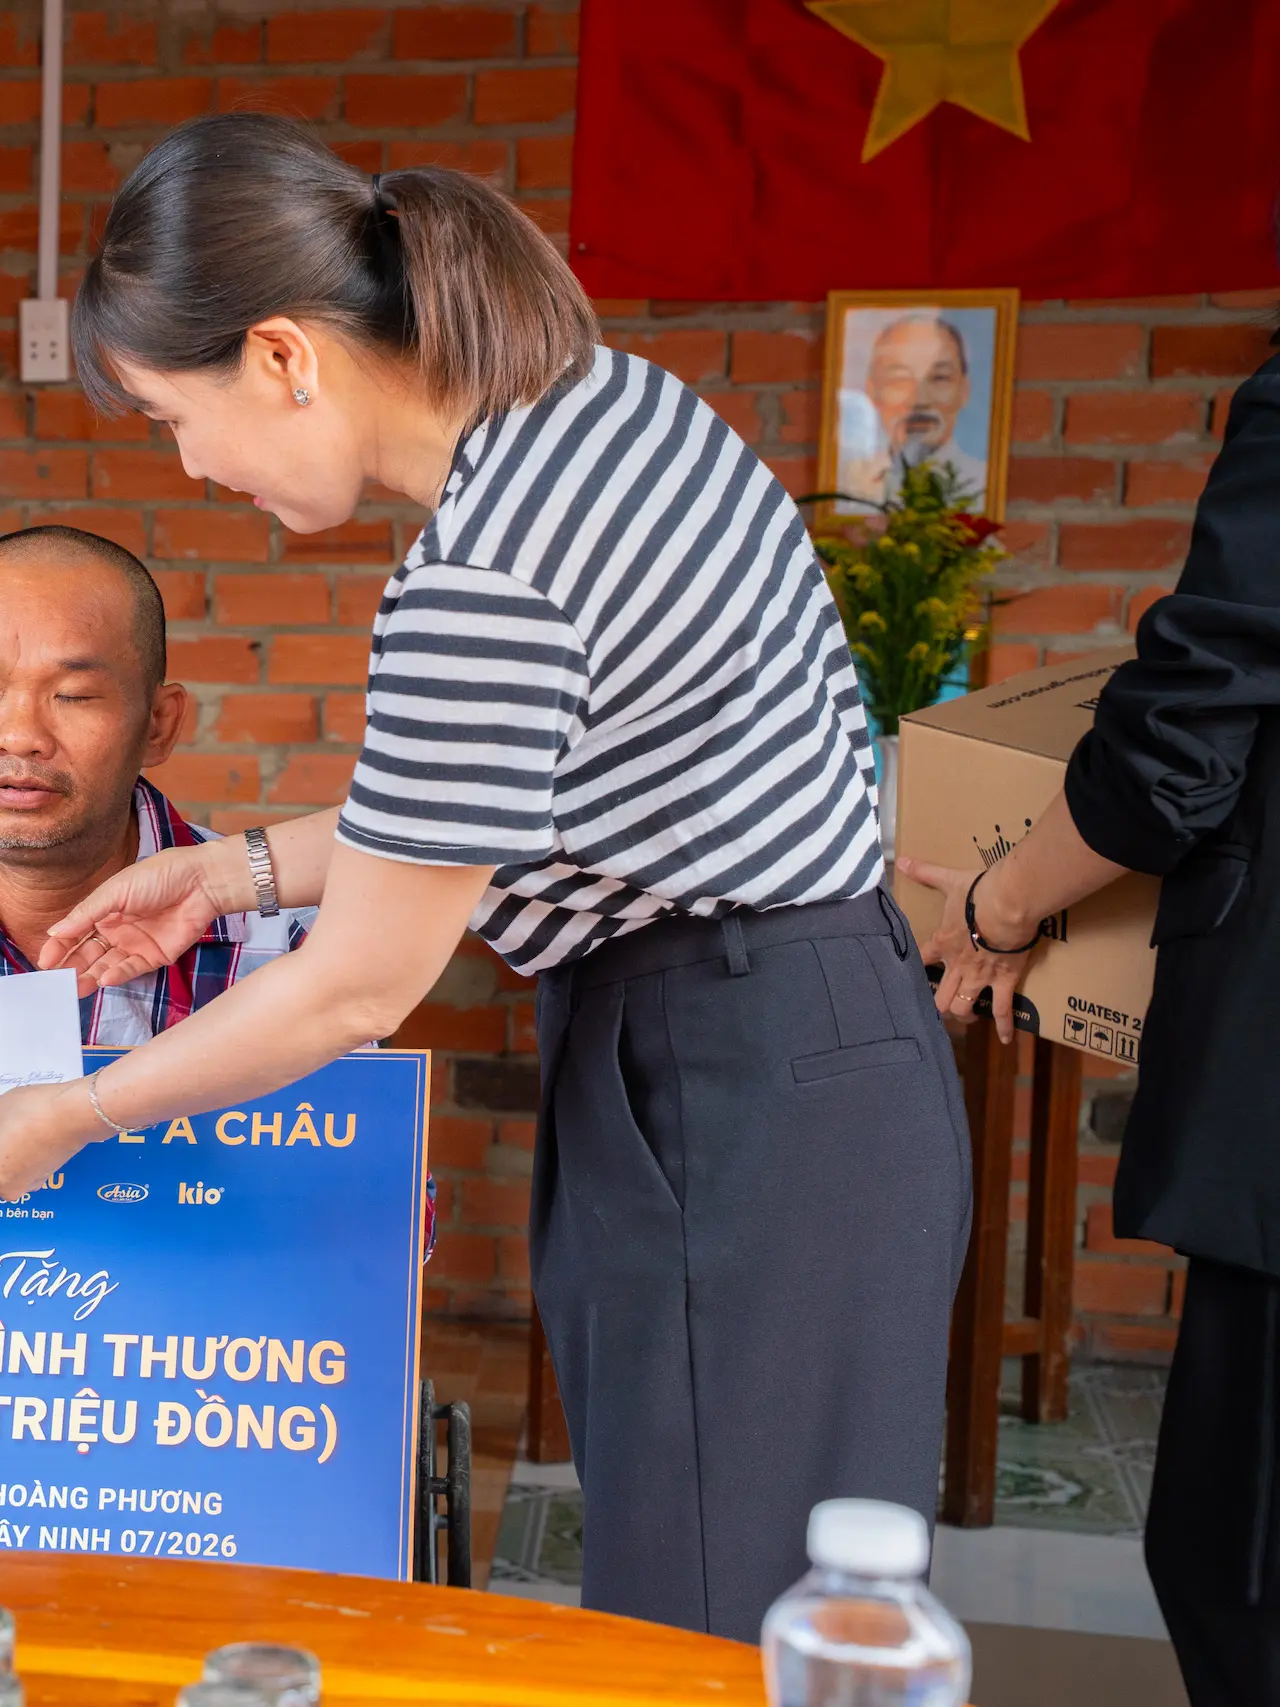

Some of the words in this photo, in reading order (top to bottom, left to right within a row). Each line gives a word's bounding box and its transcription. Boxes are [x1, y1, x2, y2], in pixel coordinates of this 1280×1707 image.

[1067, 996, 1129, 1027] QUATEST
[1132, 1018, 1142, 1031] 2
[215, 1102, 357, 1147] CHÂU
[104, 1185, 141, 1199] Asia
[178, 1181, 221, 1204] kio
[6, 1207, 29, 1218] bên
[32, 1208, 54, 1221] bạn
[103, 1334, 346, 1385] THƯƠNG
[153, 1388, 338, 1464] ĐỒNG)
[98, 1488, 222, 1515] PHƯƠNG
[38, 1526, 111, 1551] NINH
[120, 1529, 237, 1558] 07/2026
